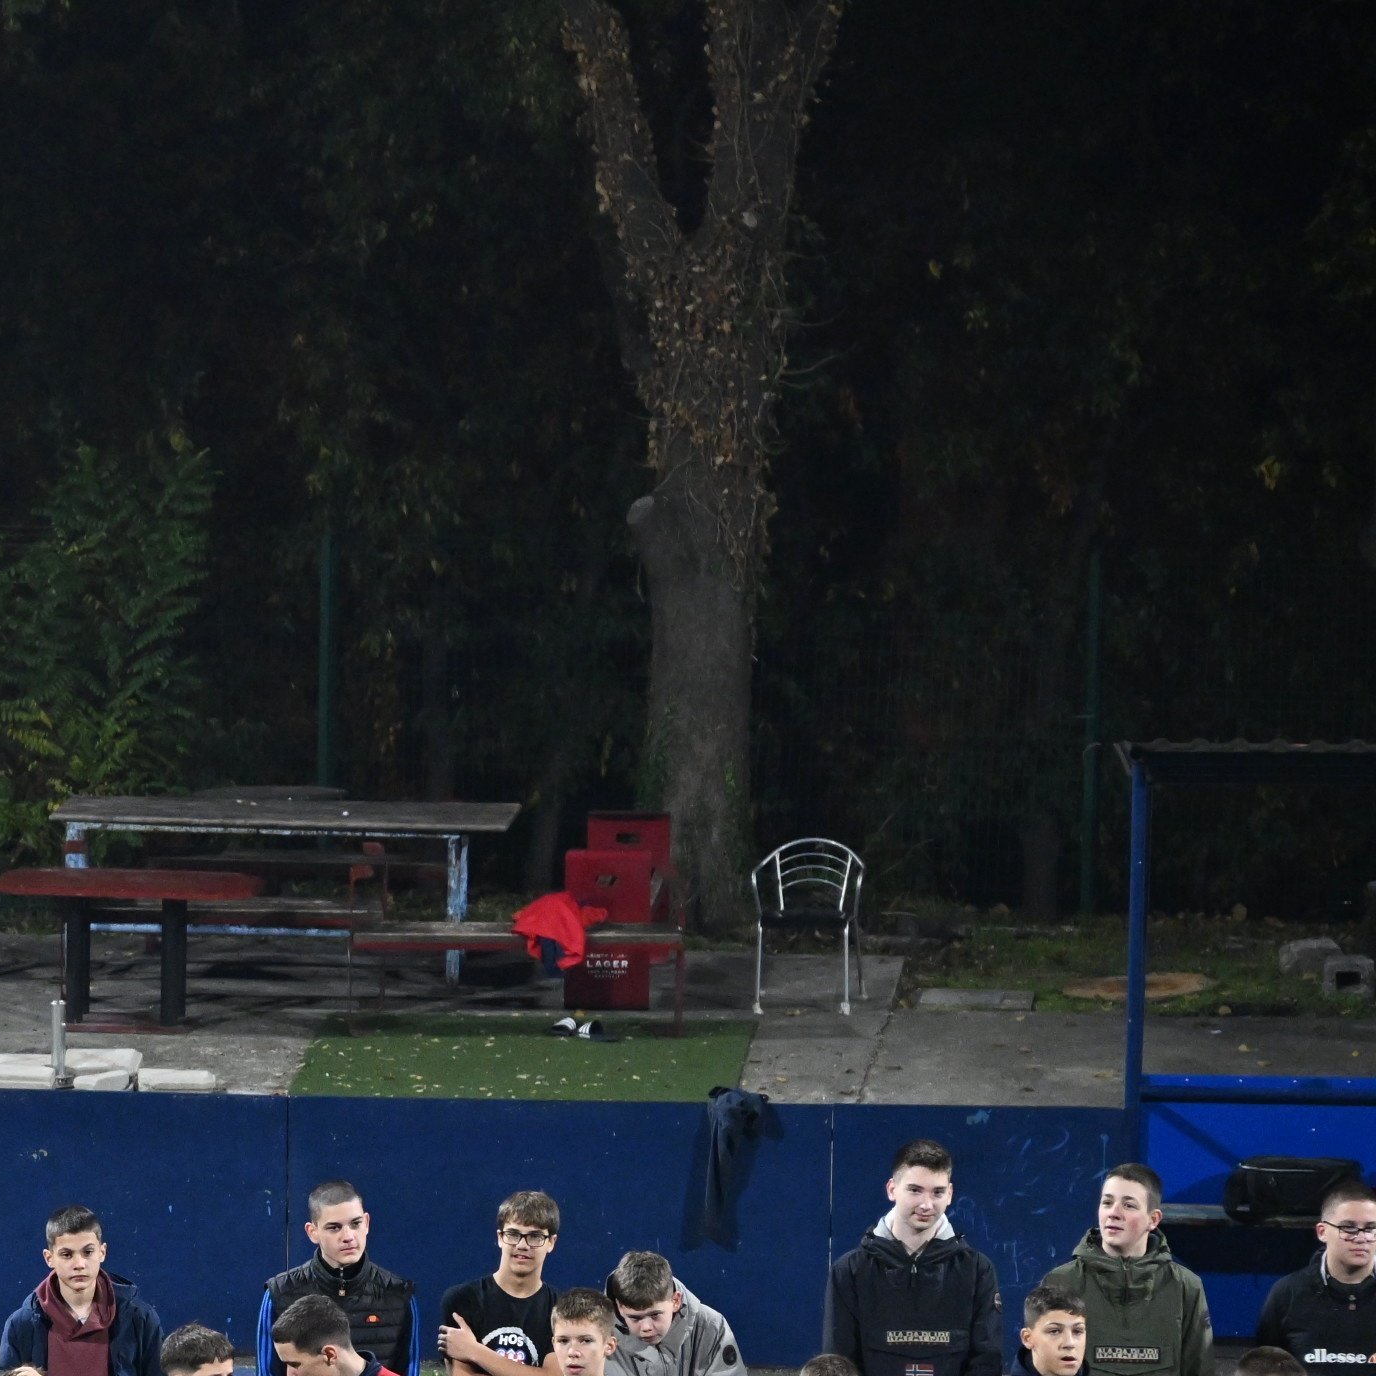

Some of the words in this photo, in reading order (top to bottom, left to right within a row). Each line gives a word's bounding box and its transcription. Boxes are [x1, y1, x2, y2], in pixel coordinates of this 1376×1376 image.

[586, 960, 629, 968] LAGER
[498, 1334, 524, 1347] HOS
[1304, 1349, 1367, 1363] ellesse
